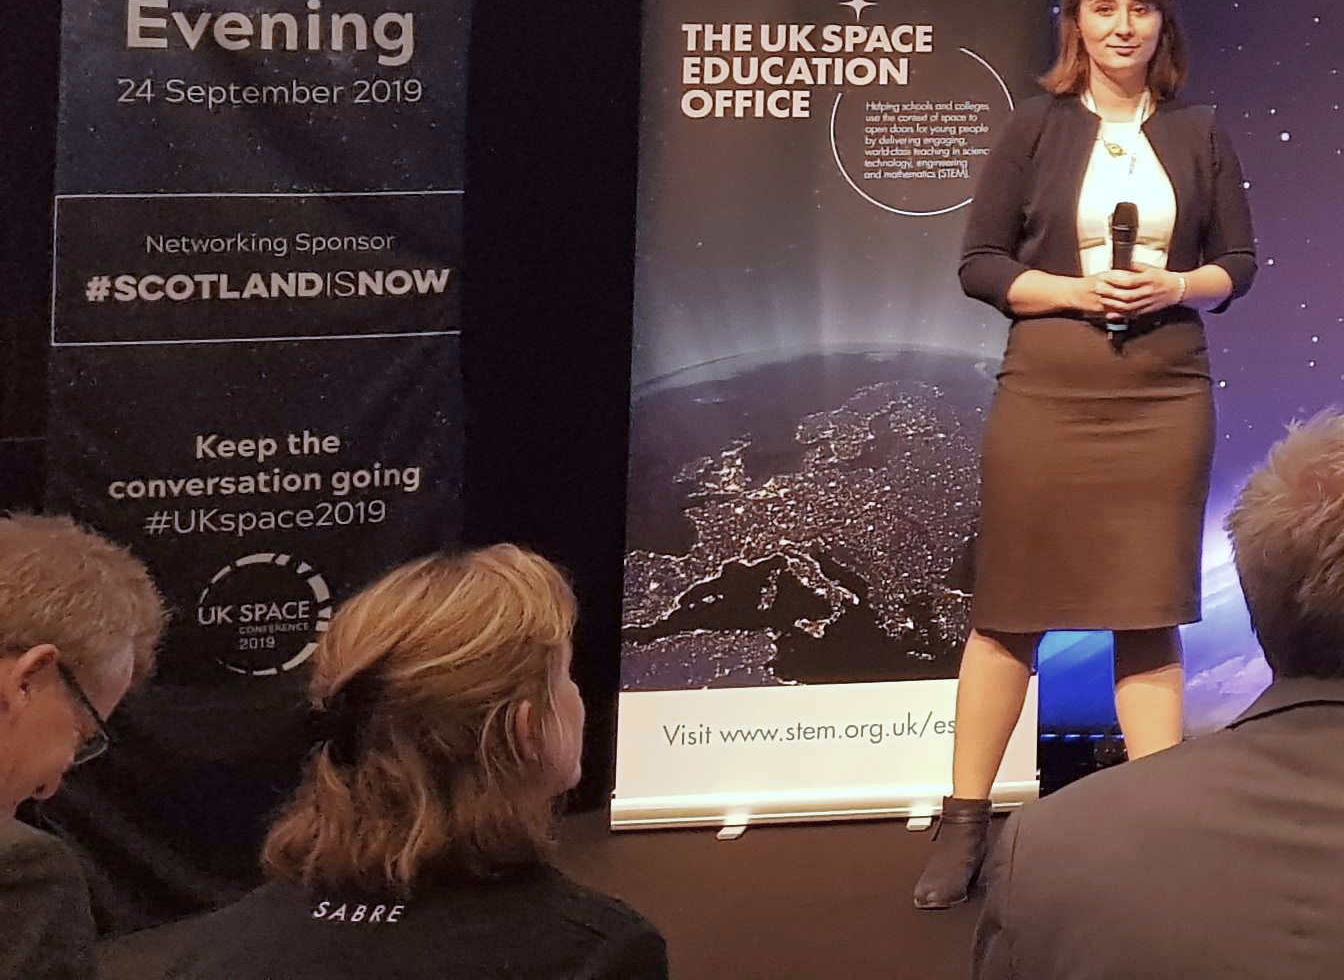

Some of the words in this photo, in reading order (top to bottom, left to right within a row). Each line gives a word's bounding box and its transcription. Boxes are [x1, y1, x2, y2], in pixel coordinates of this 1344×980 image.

[682, 24, 752, 52] THE
[761, 24, 816, 52] UK
[821, 25, 933, 53] SPACE
[682, 57, 909, 85] EDUCATION
[117, 79, 155, 104] 24
[165, 79, 343, 112] September
[353, 79, 422, 104] 2019
[681, 90, 811, 118] OFFICE
[866, 101, 900, 113] Helping
[902, 101, 933, 111] schools
[935, 101, 952, 110] and
[955, 101, 989, 112] colleges
[969, 112, 977, 121] to
[865, 125, 887, 135] open
[930, 125, 956, 135] young
[958, 124, 988, 134] people
[865, 136, 876, 148] by
[878, 136, 920, 147] delivering
[953, 147, 960, 155] in
[963, 147, 990, 156] scienc
[864, 170, 881, 179] and
[146, 233, 288, 257] Networking
[295, 232, 395, 256] Sponsor
[86, 269, 450, 302] #SCOTLANDISNOW
[196, 434, 277, 463] Keep
[288, 431, 340, 456] the
[109, 469, 321, 499] conversation
[332, 462, 420, 495] going
[145, 499, 386, 536] #UKspace2019
[199, 604, 232, 624] UK
[239, 601, 310, 621] SPACE
[240, 622, 309, 635] CONFERENCE
[240, 636, 275, 650] 2019
[663, 723, 712, 747] Visit
[720, 711, 956, 745] www.stem.org.uk/es
[313, 901, 404, 922] SABRE
